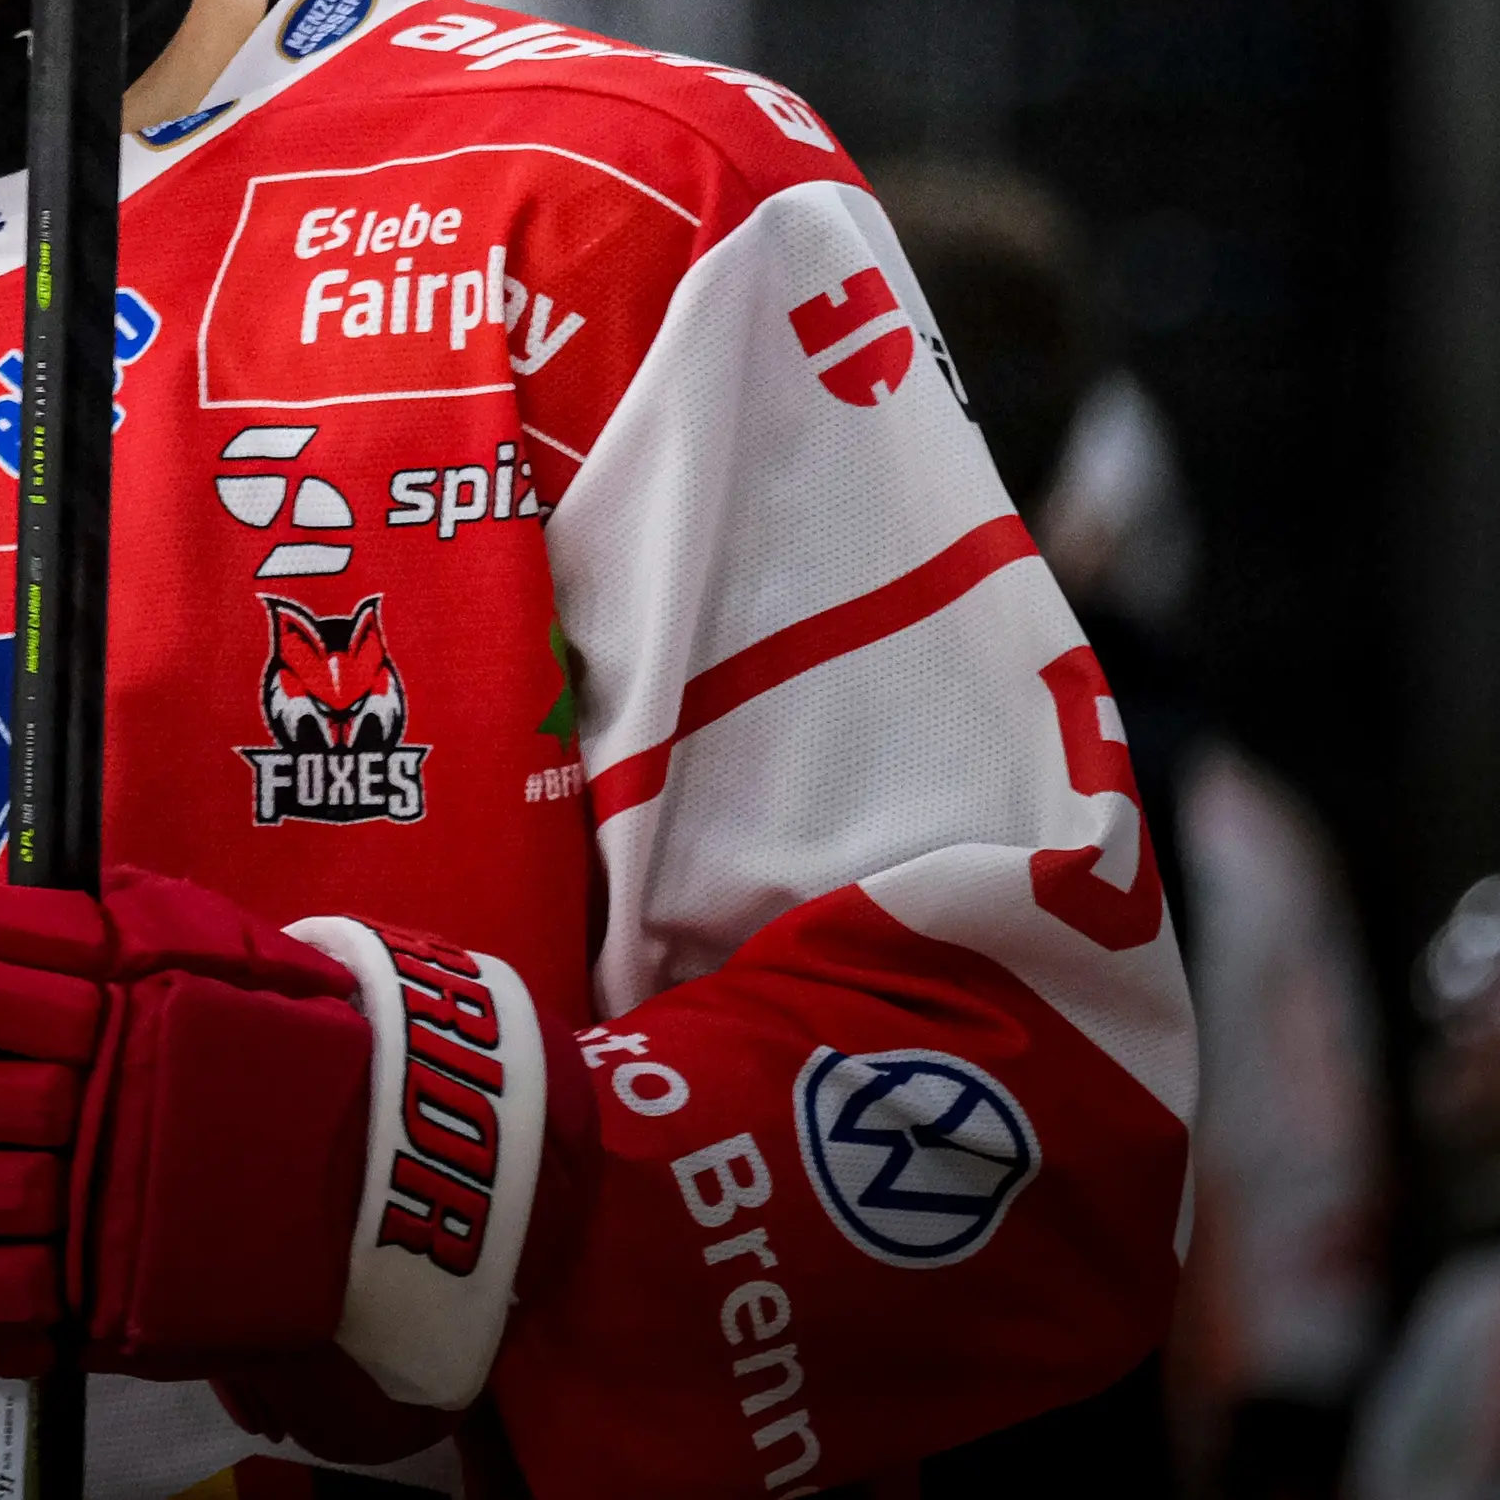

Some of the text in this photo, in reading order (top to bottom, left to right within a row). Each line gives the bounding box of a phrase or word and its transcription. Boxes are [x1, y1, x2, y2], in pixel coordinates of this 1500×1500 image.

[390, 13, 836, 153] alpa
[294, 203, 463, 260] Es lebe
[254, 747, 424, 825] FOXES
[574, 1027, 822, 1500] to Brenn
